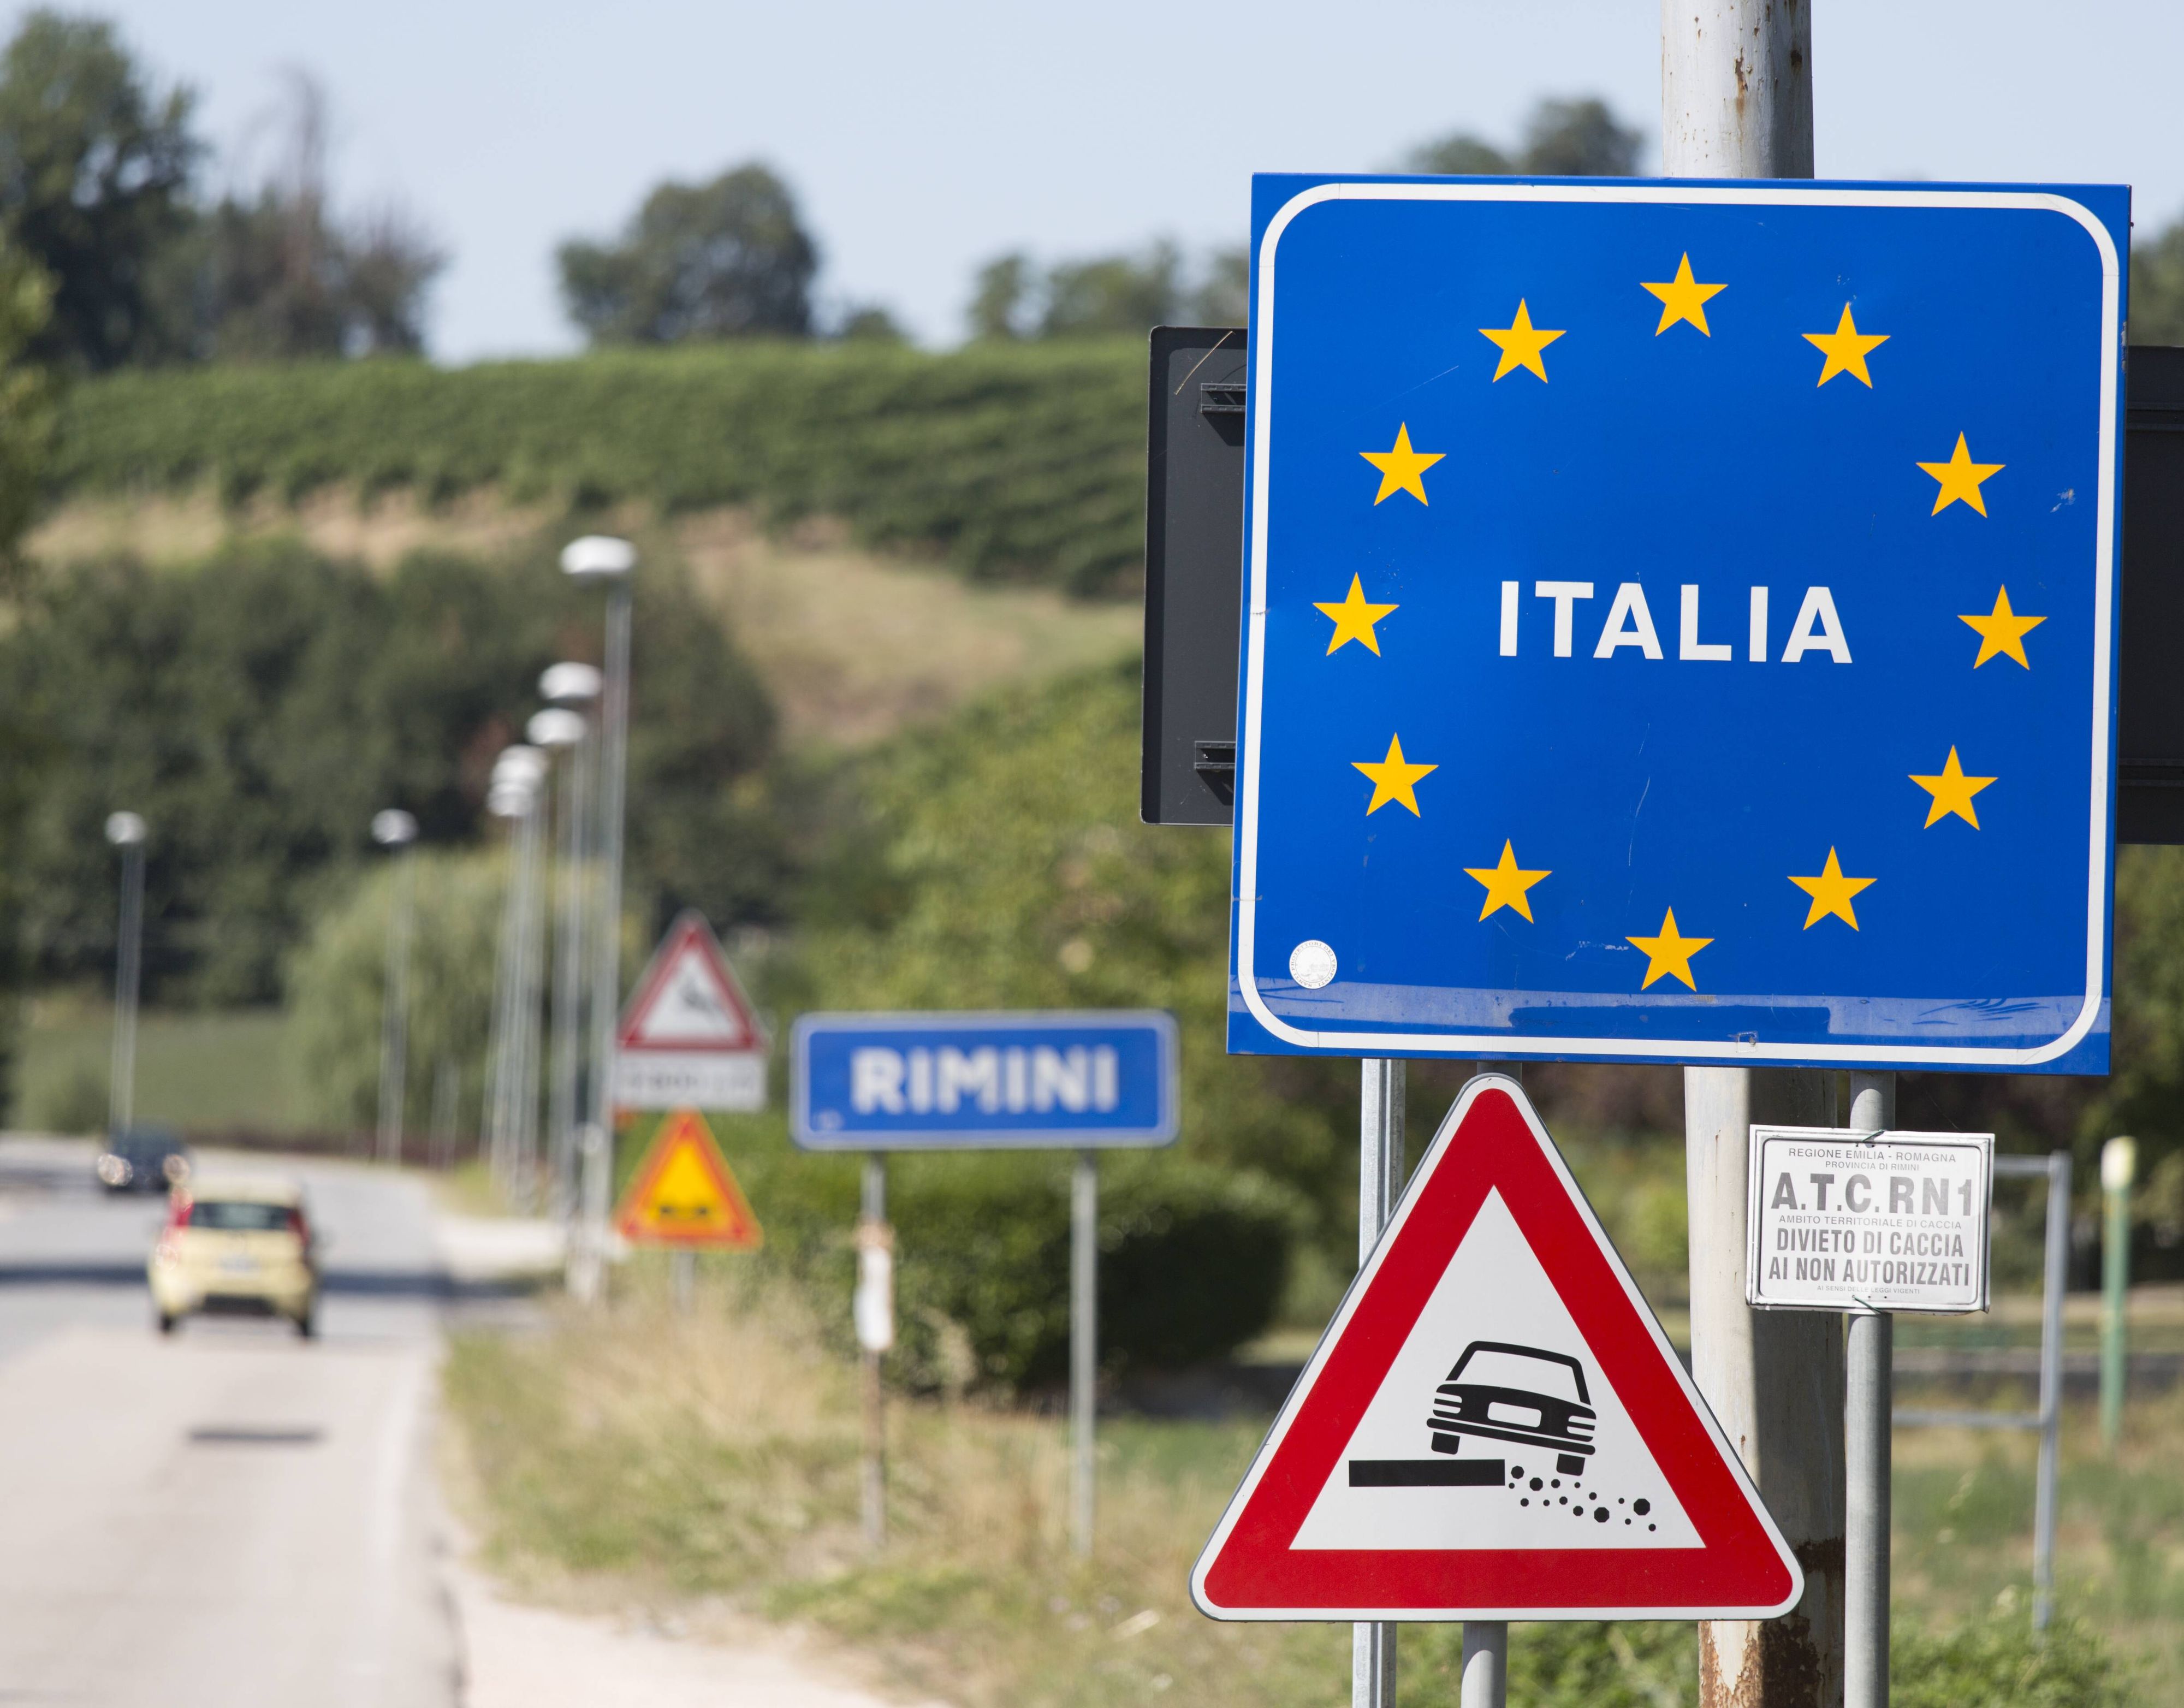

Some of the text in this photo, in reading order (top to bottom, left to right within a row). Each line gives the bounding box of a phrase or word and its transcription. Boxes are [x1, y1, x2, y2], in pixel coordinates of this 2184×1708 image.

[1499, 580, 1853, 664] ITALIA
[851, 1045, 1119, 1116] RIMINI
[1789, 1148, 1842, 1158] REGIONE
[1845, 1150, 1884, 1160] EMILIA
[1896, 1152, 1956, 1162] ROMAGNA
[1825, 1161, 1876, 1170] PROVINCIA
[1779, 1215, 1961, 1229] AMBITO TERRITORIALE DI CACCIA
[1777, 1227, 1963, 1257] DIVIETO DI CACCIA
[1768, 1256, 1971, 1286] AI NON AUTORIZZATI
